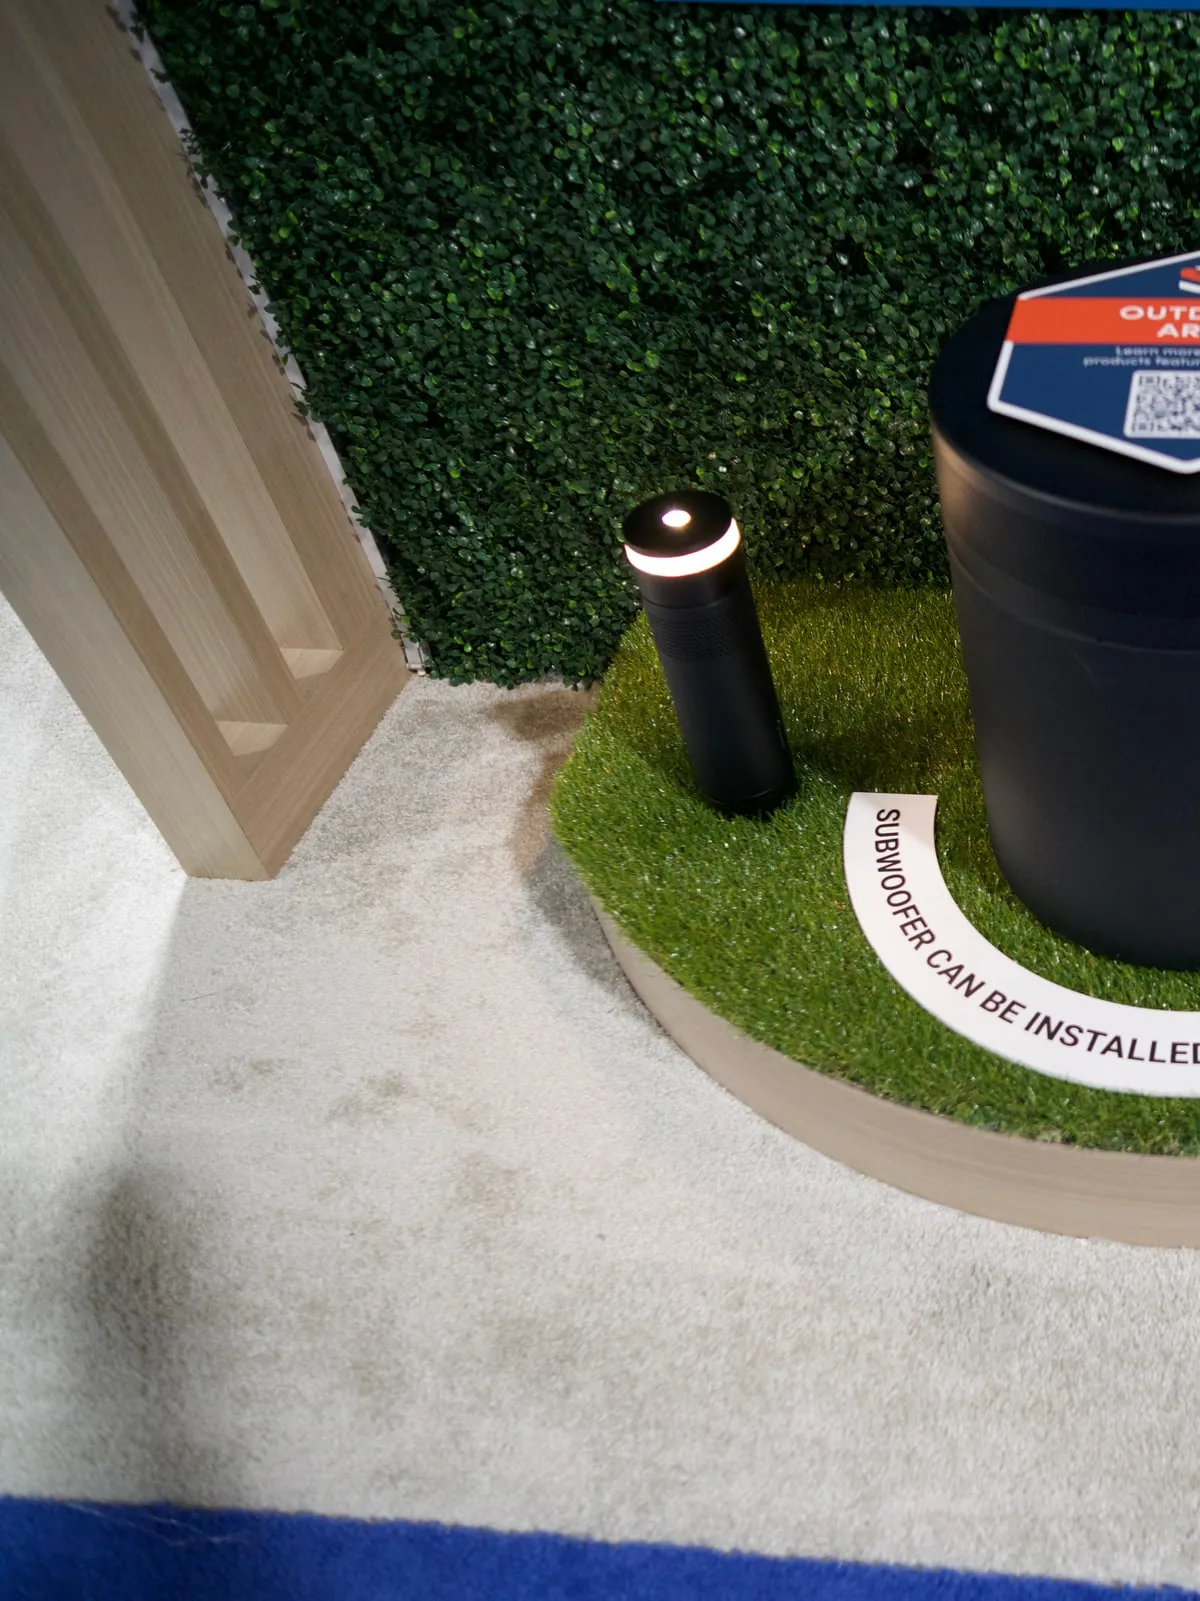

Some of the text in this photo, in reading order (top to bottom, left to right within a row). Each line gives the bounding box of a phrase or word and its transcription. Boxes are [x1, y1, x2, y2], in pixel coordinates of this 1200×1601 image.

[1115, 346, 1158, 357] Learn
[1082, 356, 1151, 367] products
[874, 808, 936, 950] SUBWOOFER
[926, 949, 986, 998] CAN
[979, 990, 1027, 1024] BE
